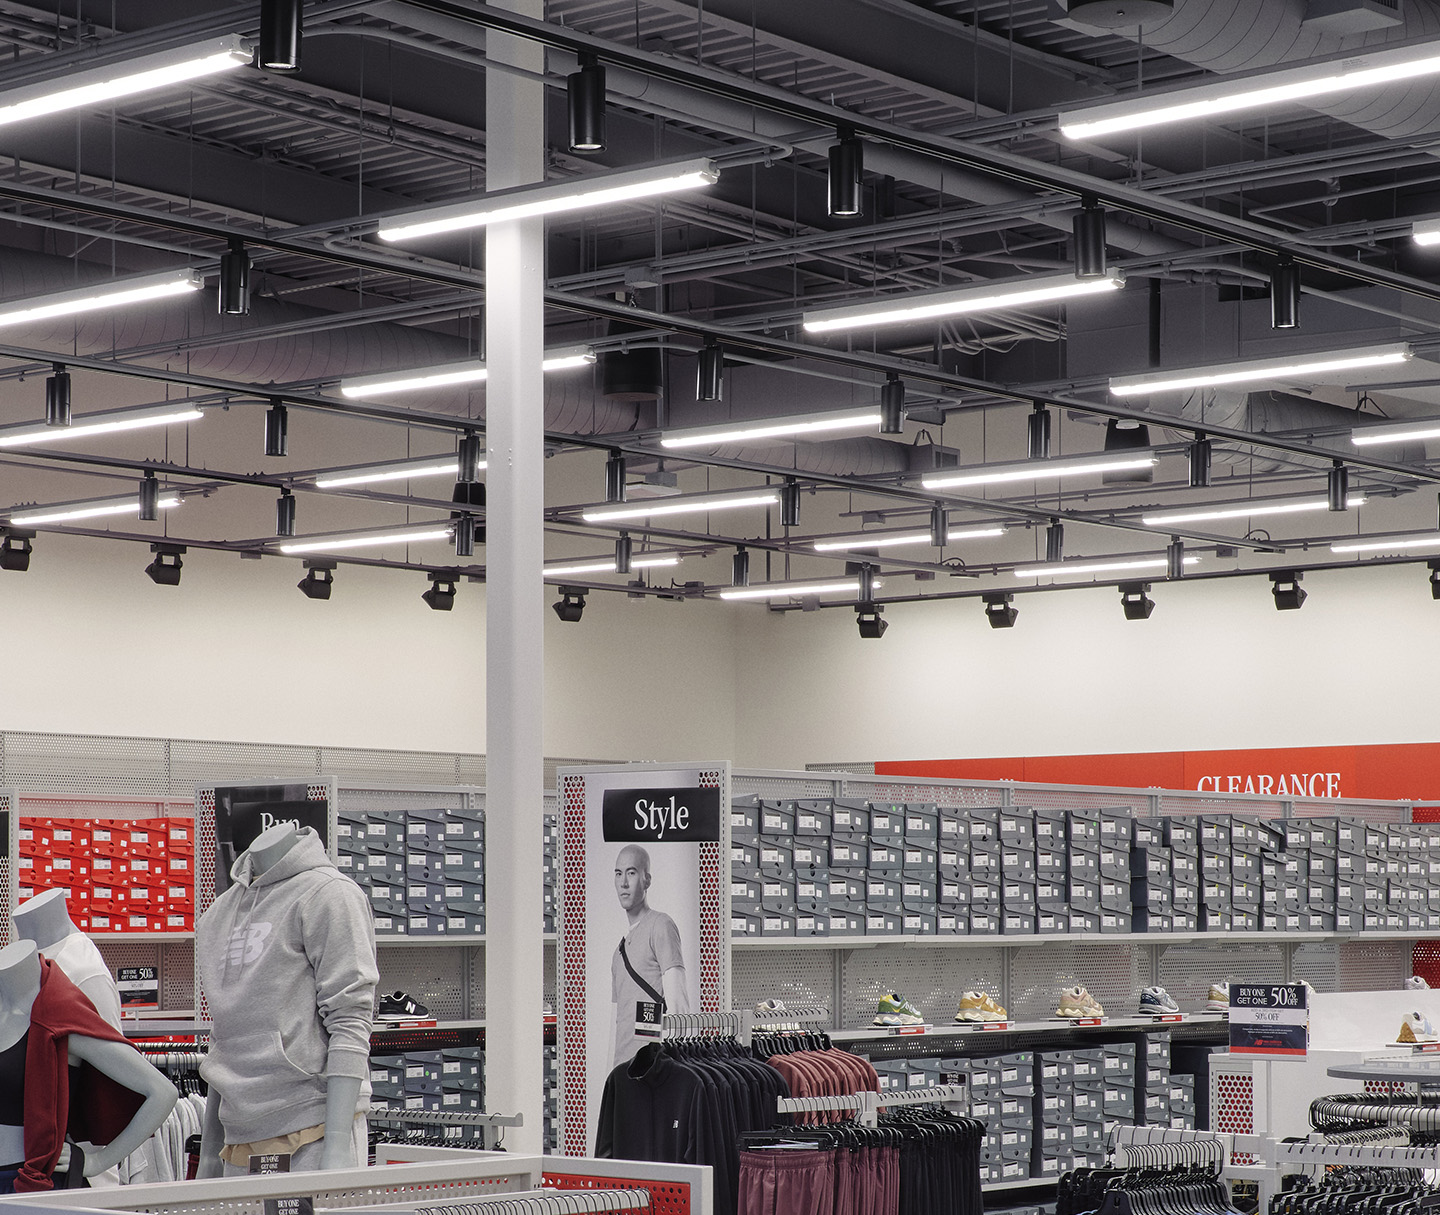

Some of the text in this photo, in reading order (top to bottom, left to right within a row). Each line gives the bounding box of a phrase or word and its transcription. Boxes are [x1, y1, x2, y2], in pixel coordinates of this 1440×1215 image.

[633, 796, 689, 839] Style
[139, 968, 153, 979] 50%
[1240, 988, 1265, 996] BUY ONE
[1271, 987, 1296, 1007] 50%
